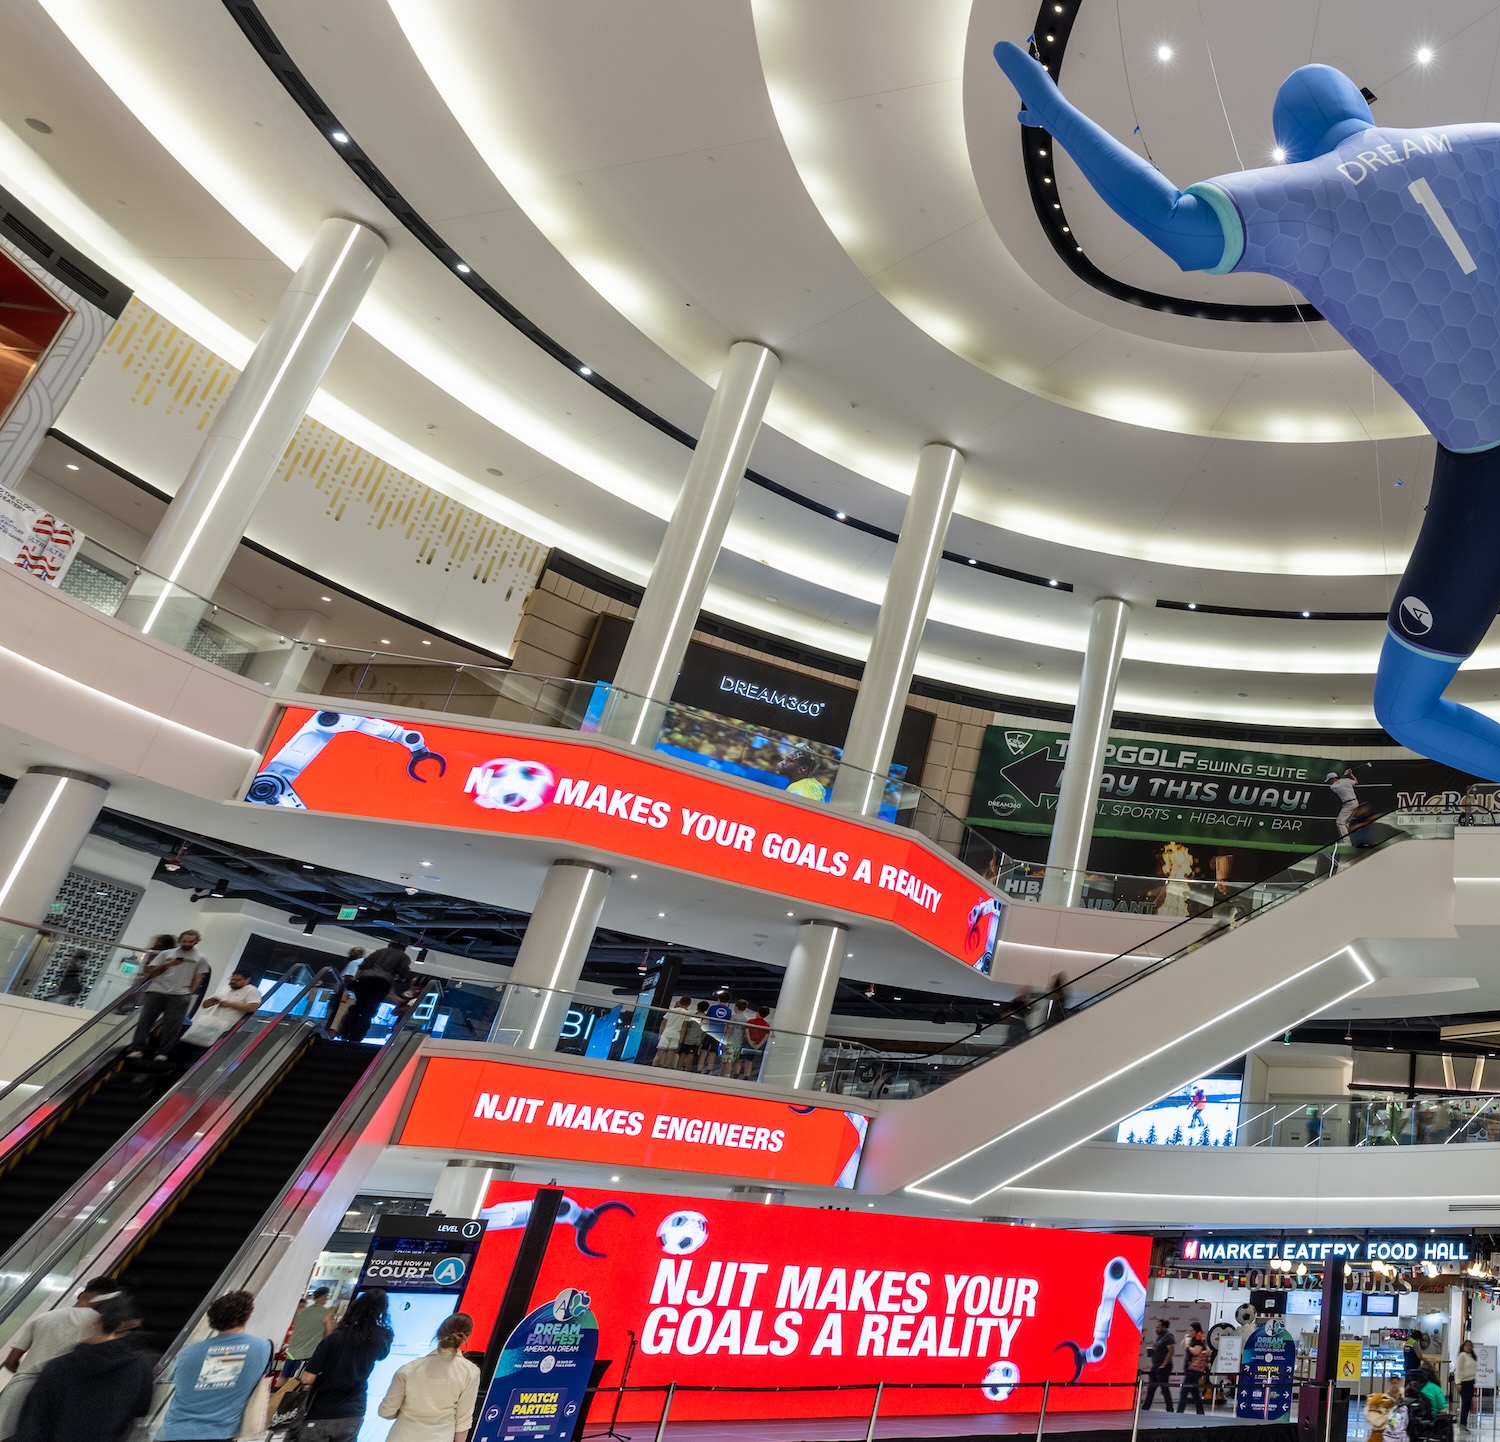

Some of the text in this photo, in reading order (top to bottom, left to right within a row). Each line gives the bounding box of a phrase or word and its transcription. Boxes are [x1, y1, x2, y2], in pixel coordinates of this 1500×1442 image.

[1336, 132, 1454, 186] DREAM
[1407, 176, 1478, 275] 1
[1055, 739, 1308, 780] TPGOLF SWING SUITE
[1149, 777, 1219, 801] THIS
[1228, 785, 1312, 811] WAY!
[1111, 805, 1170, 821] SPORTS
[1190, 811, 1252, 828] HIBACHI
[1271, 818, 1303, 832] BAR
[1399, 816, 1424, 824] BAR
[552, 777, 672, 829] MAKES
[681, 807, 757, 853] YOUR
[762, 832, 850, 877] GOALS
[852, 858, 873, 885] A
[878, 863, 942, 914] REALITY
[474, 1092, 785, 1153] NJIT MAKES ENGINEERS
[438, 1225, 459, 1233] LEVEL
[1199, 1243, 1278, 1260] MARKET
[1283, 1243, 1360, 1260] EATERY
[1367, 1243, 1418, 1260] FOOD
[1424, 1243, 1469, 1260] HALL
[366, 1263, 456, 1280] COURT A
[648, 1258, 1040, 1318] NJIT MAKES YOUR
[533, 1322, 582, 1335] DREAM
[639, 1306, 1023, 1358] GOALS A REALITY
[523, 1345, 580, 1353] AMERICAN DREAM
[1257, 1365, 1279, 1373] WATCH
[520, 1392, 559, 1404] WATCH
[511, 1404, 557, 1415] PARTIES
